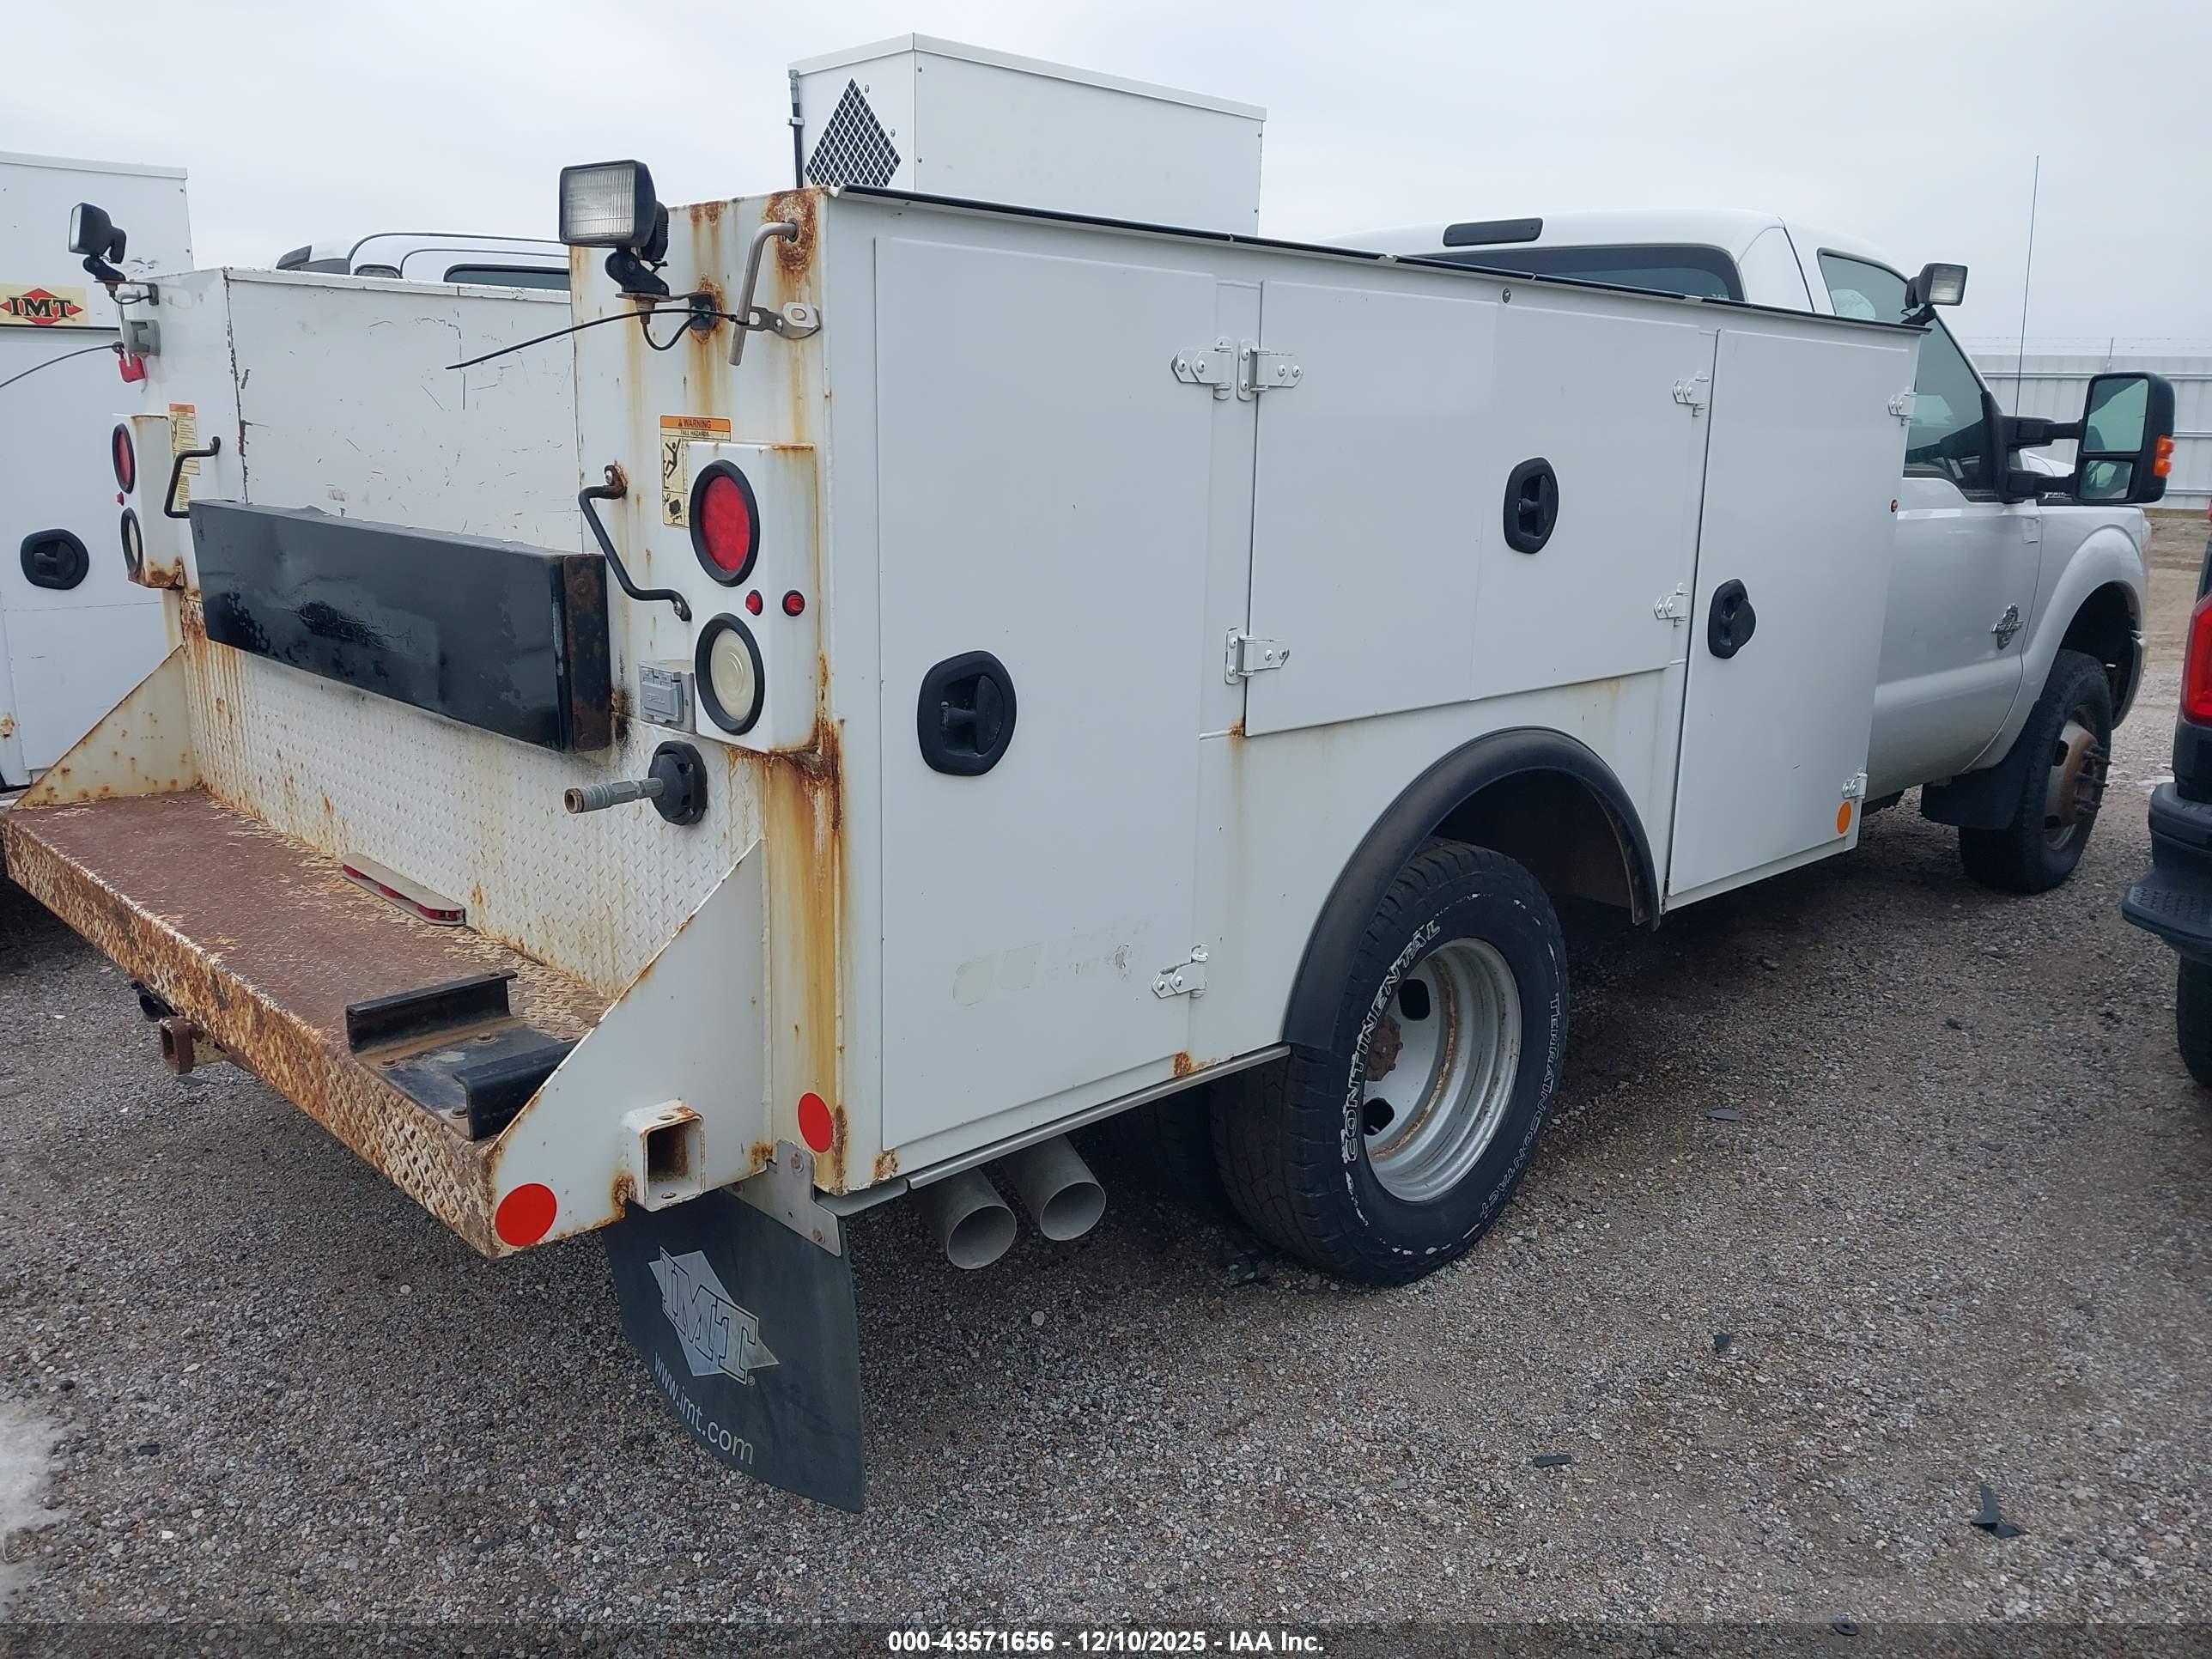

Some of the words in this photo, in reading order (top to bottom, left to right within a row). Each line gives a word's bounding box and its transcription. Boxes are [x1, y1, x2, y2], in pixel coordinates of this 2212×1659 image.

[8, 296, 73, 318] IMT
[684, 418, 712, 429] WARNING
[646, 693, 665, 705] BELL
[1341, 919, 1442, 1164] CONTINENTAL
[660, 1246, 759, 1385] IMT
[654, 1352, 756, 1466] www.imt.com
